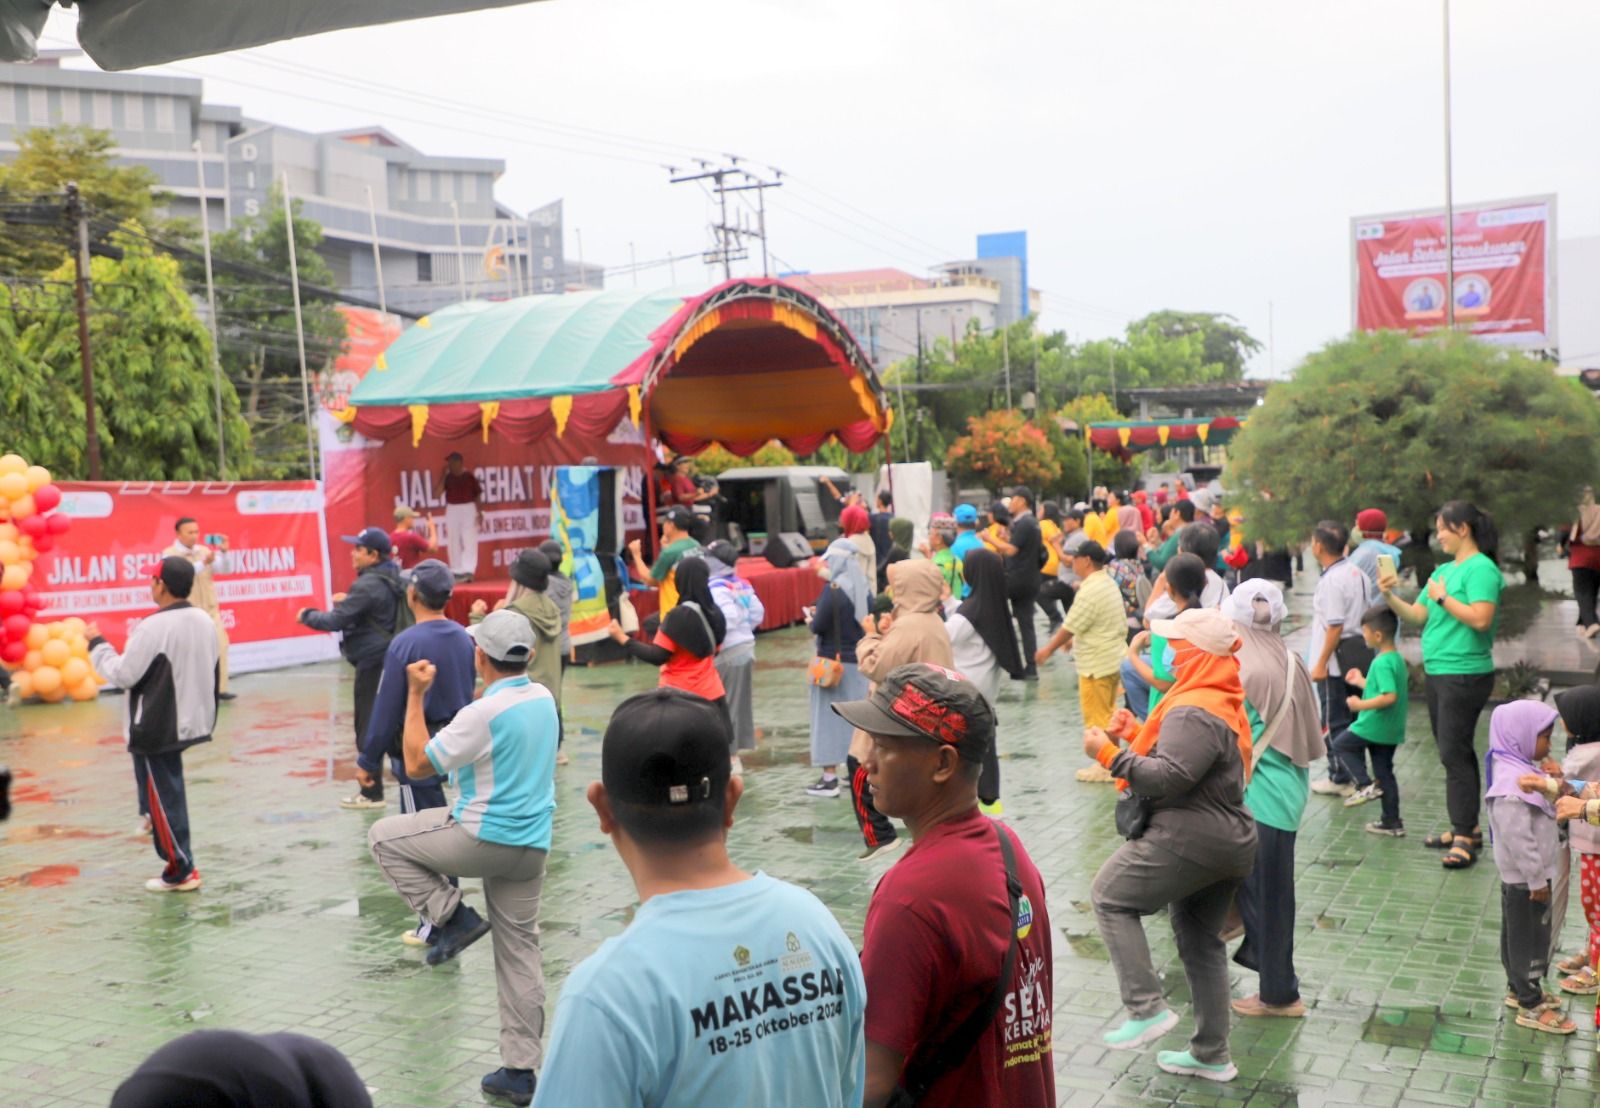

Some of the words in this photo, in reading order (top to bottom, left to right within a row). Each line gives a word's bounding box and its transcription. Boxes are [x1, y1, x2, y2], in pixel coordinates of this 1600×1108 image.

[47, 555, 117, 585] JALAN
[708, 1028, 752, 1055] 18-25
[756, 1011, 814, 1039] Oktober
